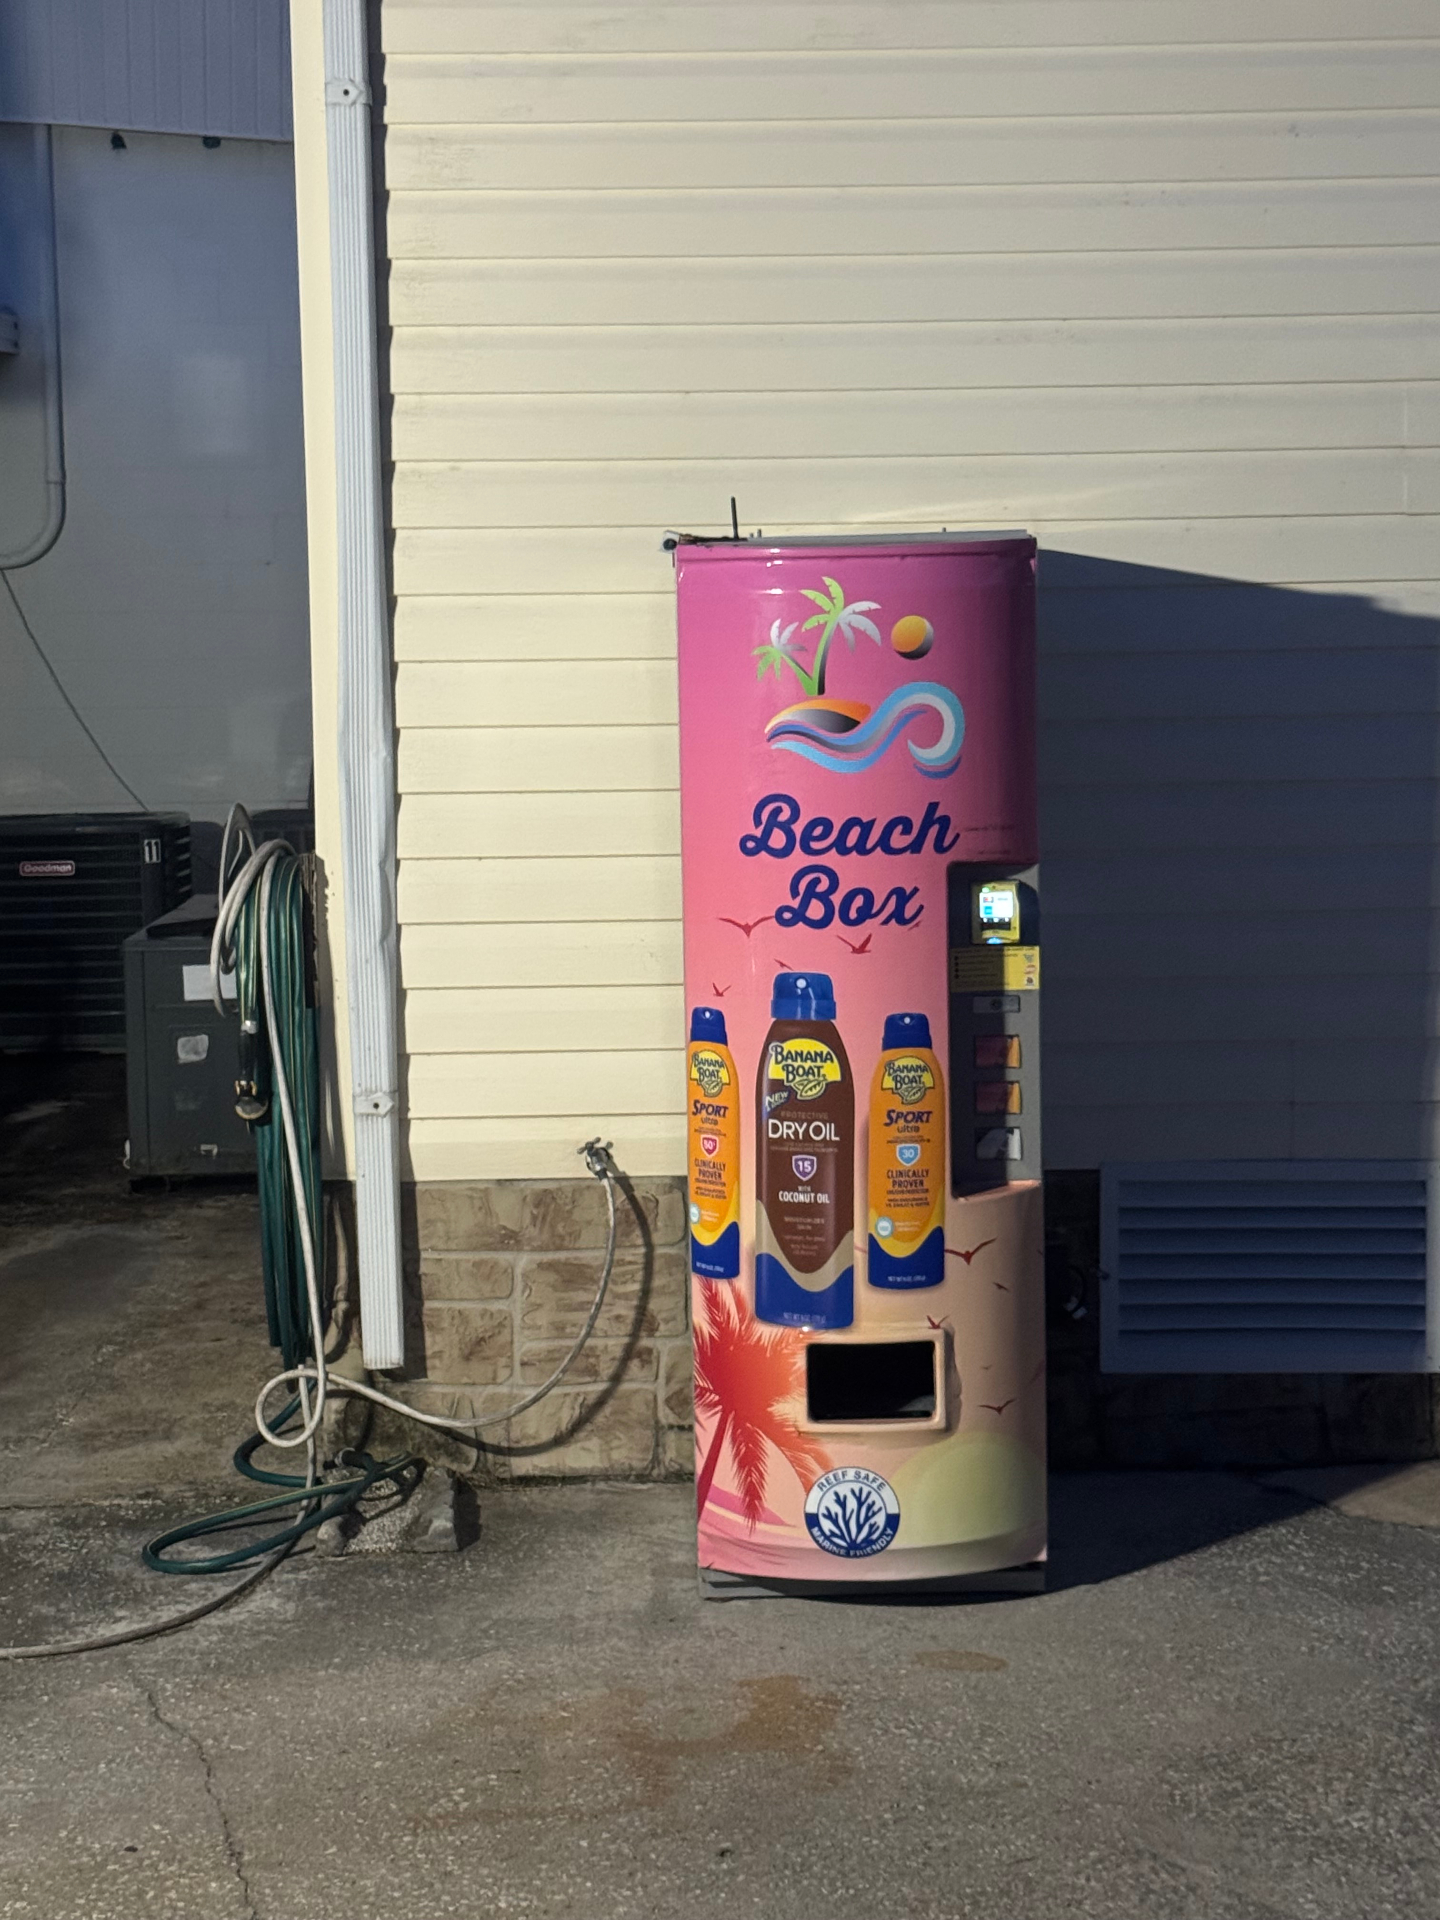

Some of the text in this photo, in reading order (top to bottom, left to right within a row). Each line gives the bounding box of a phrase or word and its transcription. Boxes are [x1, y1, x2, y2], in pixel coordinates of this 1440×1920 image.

[739, 793, 960, 859] Beach
[145, 840, 161, 862] 11
[24, 863, 72, 873] Goodman
[775, 864, 924, 929] Box
[692, 1051, 725, 1068] BANANA
[771, 1044, 834, 1065] BANANA
[697, 1066, 720, 1082] BOAT
[782, 1063, 824, 1083] BOAT
[886, 1061, 928, 1076] BANANA
[892, 1074, 923, 1090] BOAT
[765, 1091, 789, 1107] NEW
[692, 1099, 729, 1119] SPORT
[884, 1109, 933, 1126] SPORT
[768, 1119, 840, 1141] DRY OIL
[902, 1148, 915, 1158] 30
[798, 1161, 811, 1173] 15
[886, 1169, 929, 1179] CLINICALLY
[892, 1179, 924, 1188] PROVEN
[779, 1191, 830, 1204] COCONUT OIL
[817, 1470, 886, 1492] REEF SAFE
[811, 1526, 894, 1556] MARINE FRIENDLY
